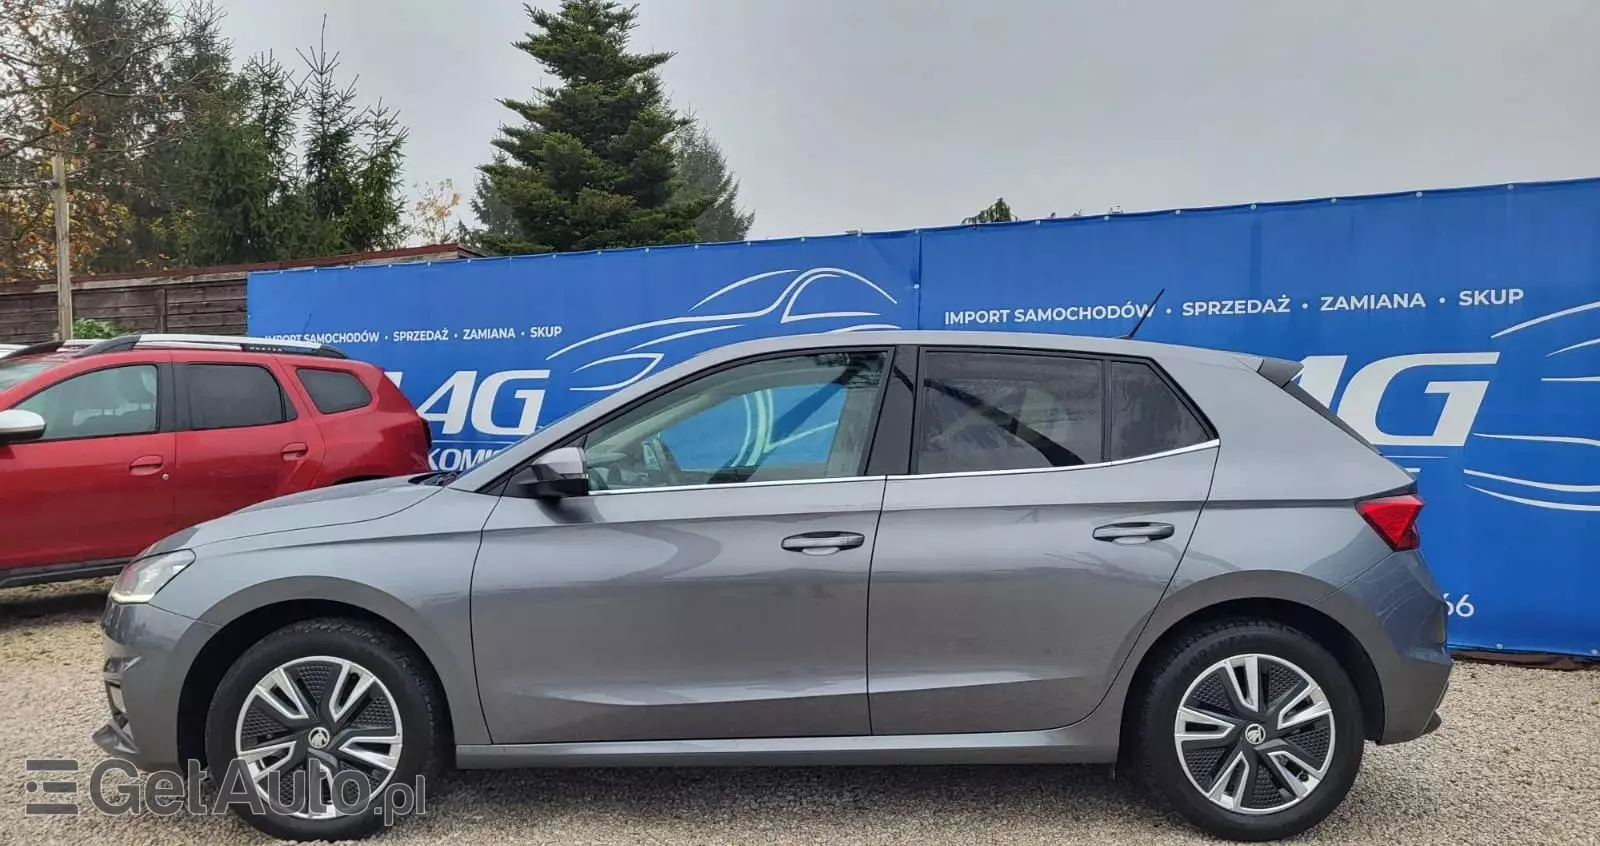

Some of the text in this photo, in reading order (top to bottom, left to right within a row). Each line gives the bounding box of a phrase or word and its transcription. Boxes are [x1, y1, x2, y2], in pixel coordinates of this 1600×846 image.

[944, 288, 1524, 325] IMPORT SAMOCHODÓW SPRZEDAŻ ZAMIANA SKUP
[303, 330, 380, 343] SAMOCHODÓW
[393, 327, 449, 342] SPRZEDAŻ
[462, 327, 516, 340] ZAMIANA
[530, 326, 562, 338] SKUP
[384, 370, 550, 436] AG
